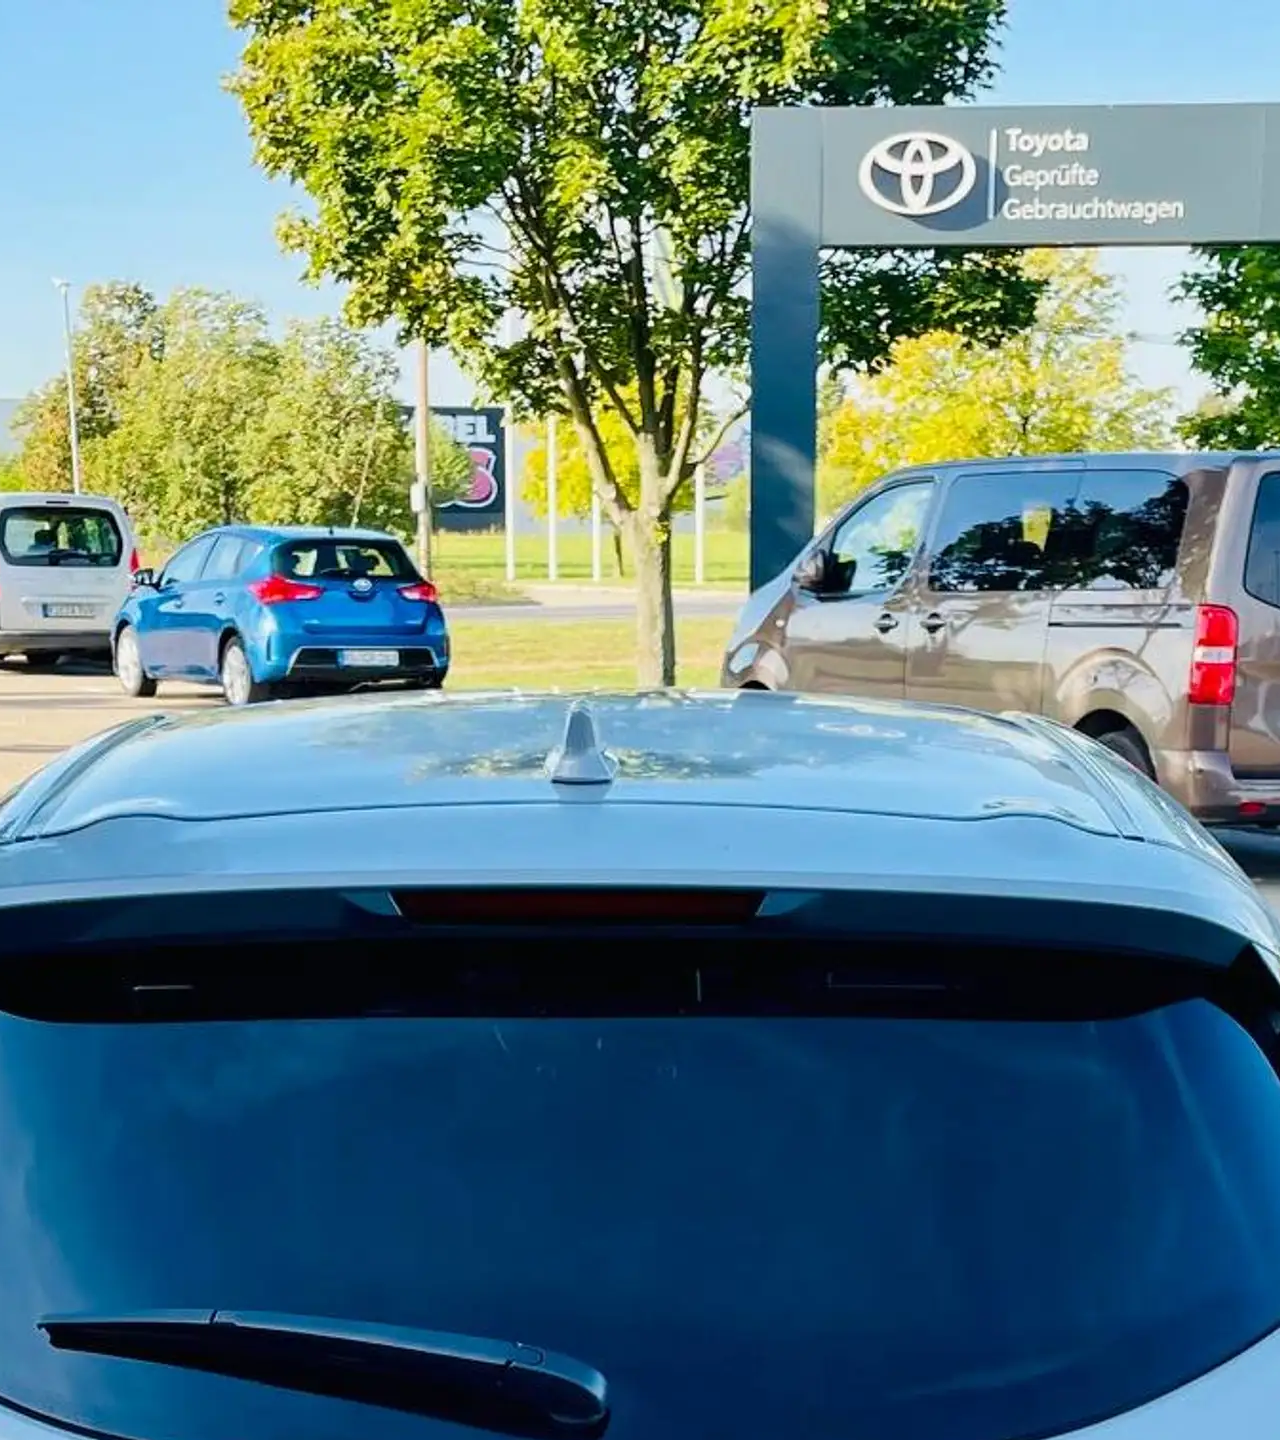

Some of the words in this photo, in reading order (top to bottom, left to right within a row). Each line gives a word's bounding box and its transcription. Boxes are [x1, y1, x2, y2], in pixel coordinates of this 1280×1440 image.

[1005, 127, 1090, 158] Toyota
[1002, 162, 1100, 191] Geprüfte
[1001, 196, 1185, 225] Gebrauchtwagen
